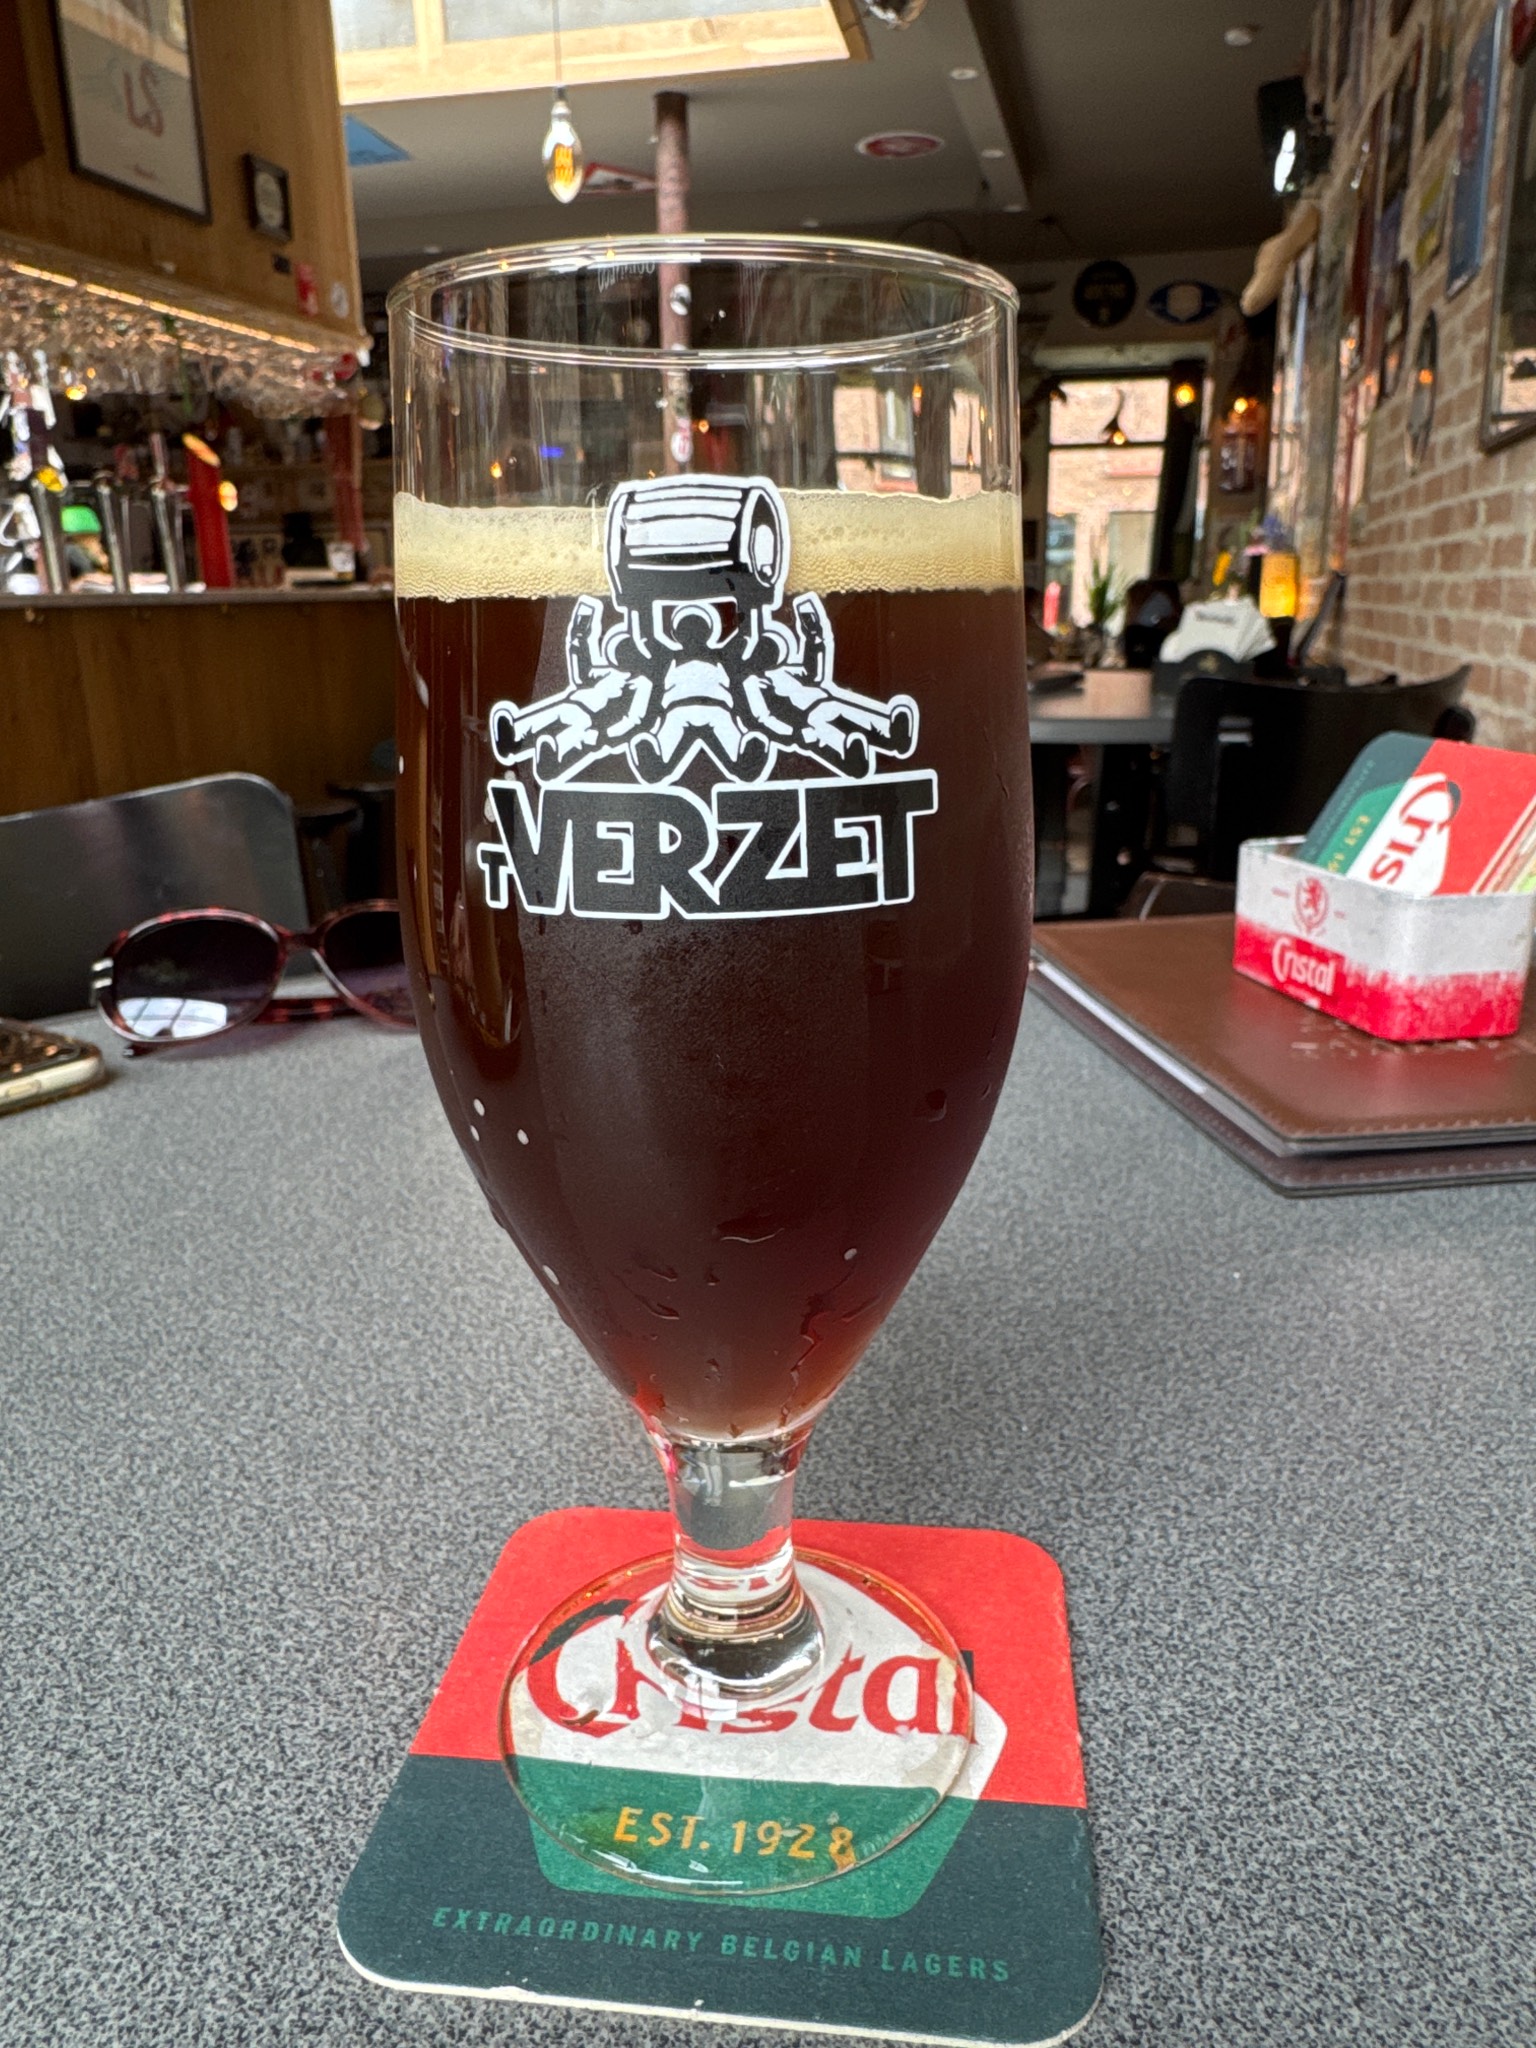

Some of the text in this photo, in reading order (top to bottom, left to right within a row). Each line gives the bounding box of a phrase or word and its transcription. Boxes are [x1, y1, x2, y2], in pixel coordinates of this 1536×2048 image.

[487, 769, 938, 920] VERZET
[1368, 776, 1462, 886] Cris
[1271, 937, 1336, 996] Cristal
[614, 1806, 858, 1872] EST. 1928
[431, 1906, 1011, 1983] EXTRAORDINARY BELGIAN LAGERS
